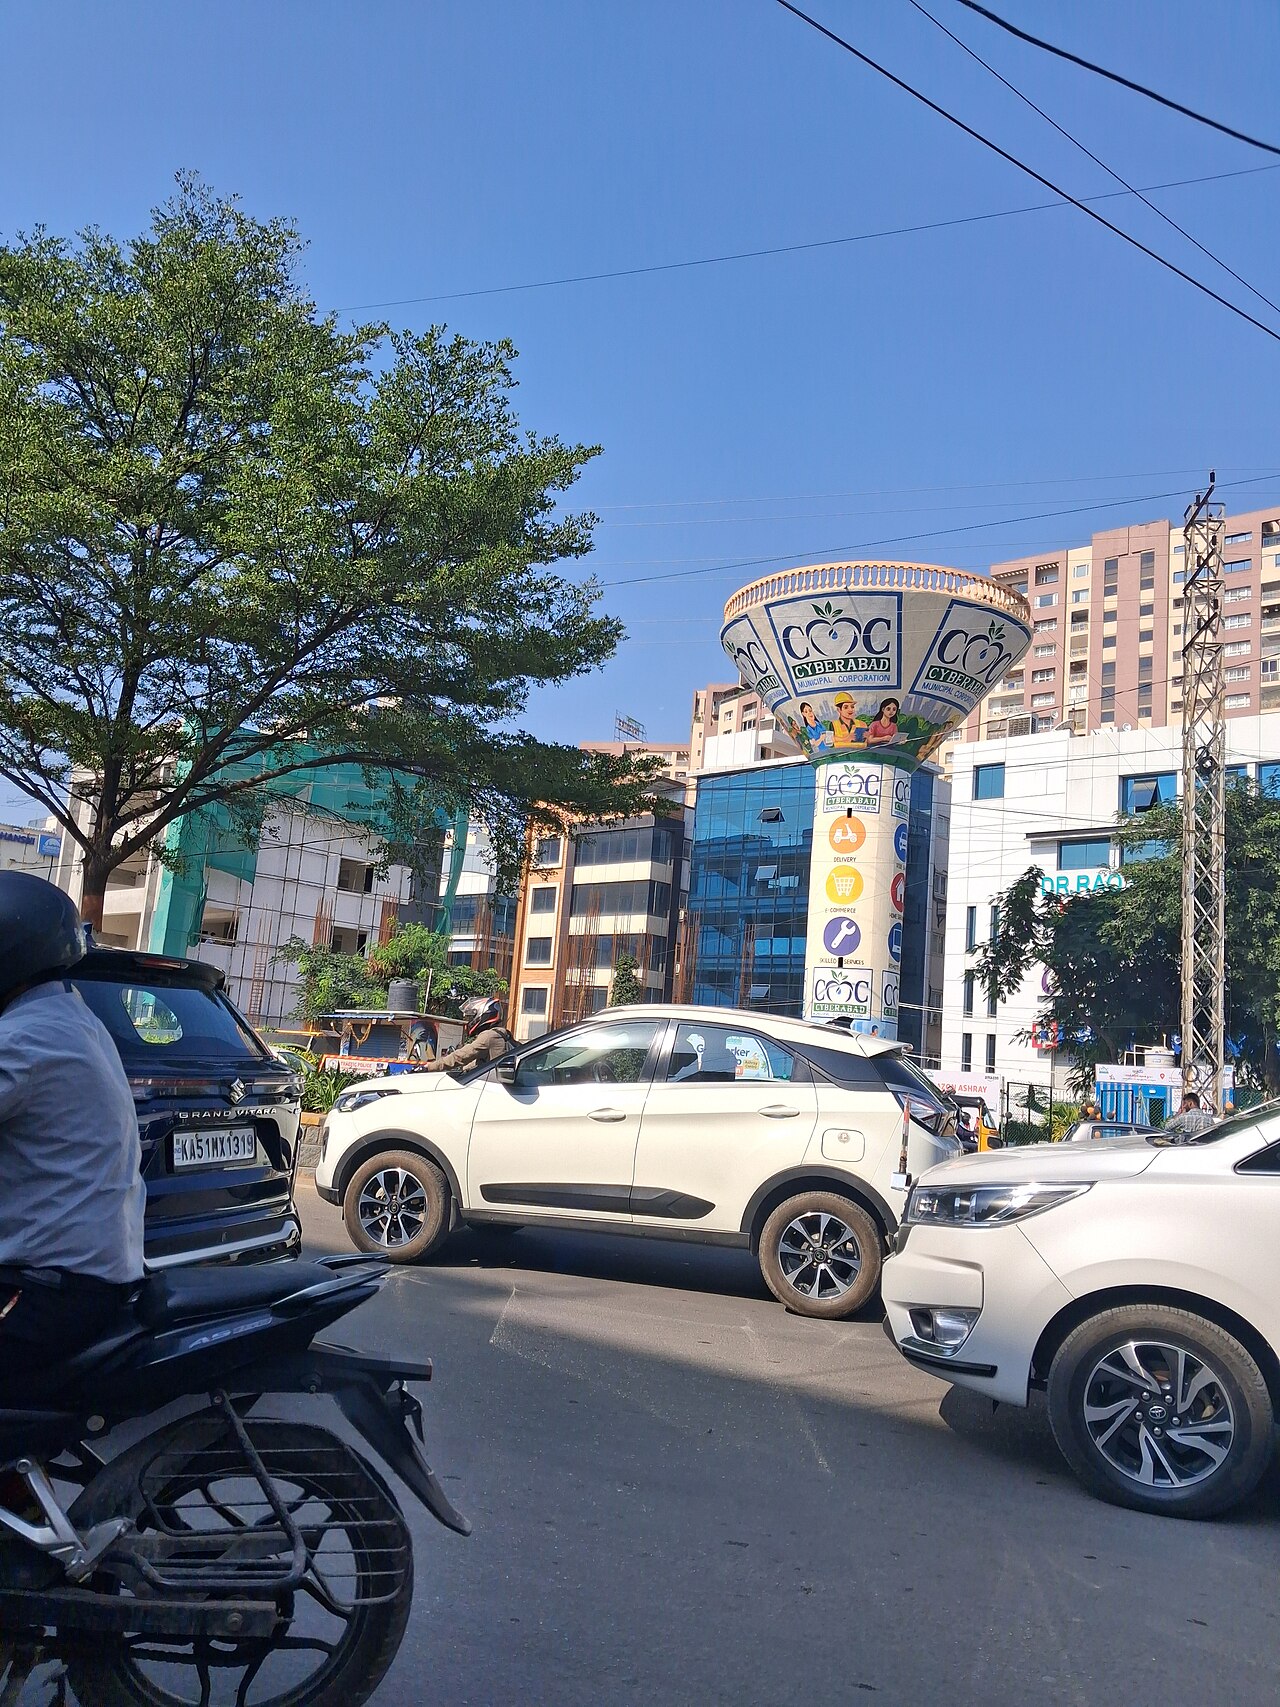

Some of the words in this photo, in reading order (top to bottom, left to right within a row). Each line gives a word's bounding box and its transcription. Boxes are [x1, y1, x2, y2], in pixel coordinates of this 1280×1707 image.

[794, 657, 890, 679] CYBERABAD
[797, 676, 833, 688] MUNICIPAL
[838, 673, 891, 684] CORPORATION
[921, 682, 954, 695] MUNICIPAL
[827, 797, 876, 806] CYBERABAD
[843, 958, 865, 966] SERVICES
[815, 1003, 866, 1014] CYBERABAD
[957, 1084, 988, 1094] ASHRAY
[179, 1110, 232, 1119] GRAND
[236, 1107, 277, 1117] VITARA
[181, 1133, 254, 1162] KA51MX1319
